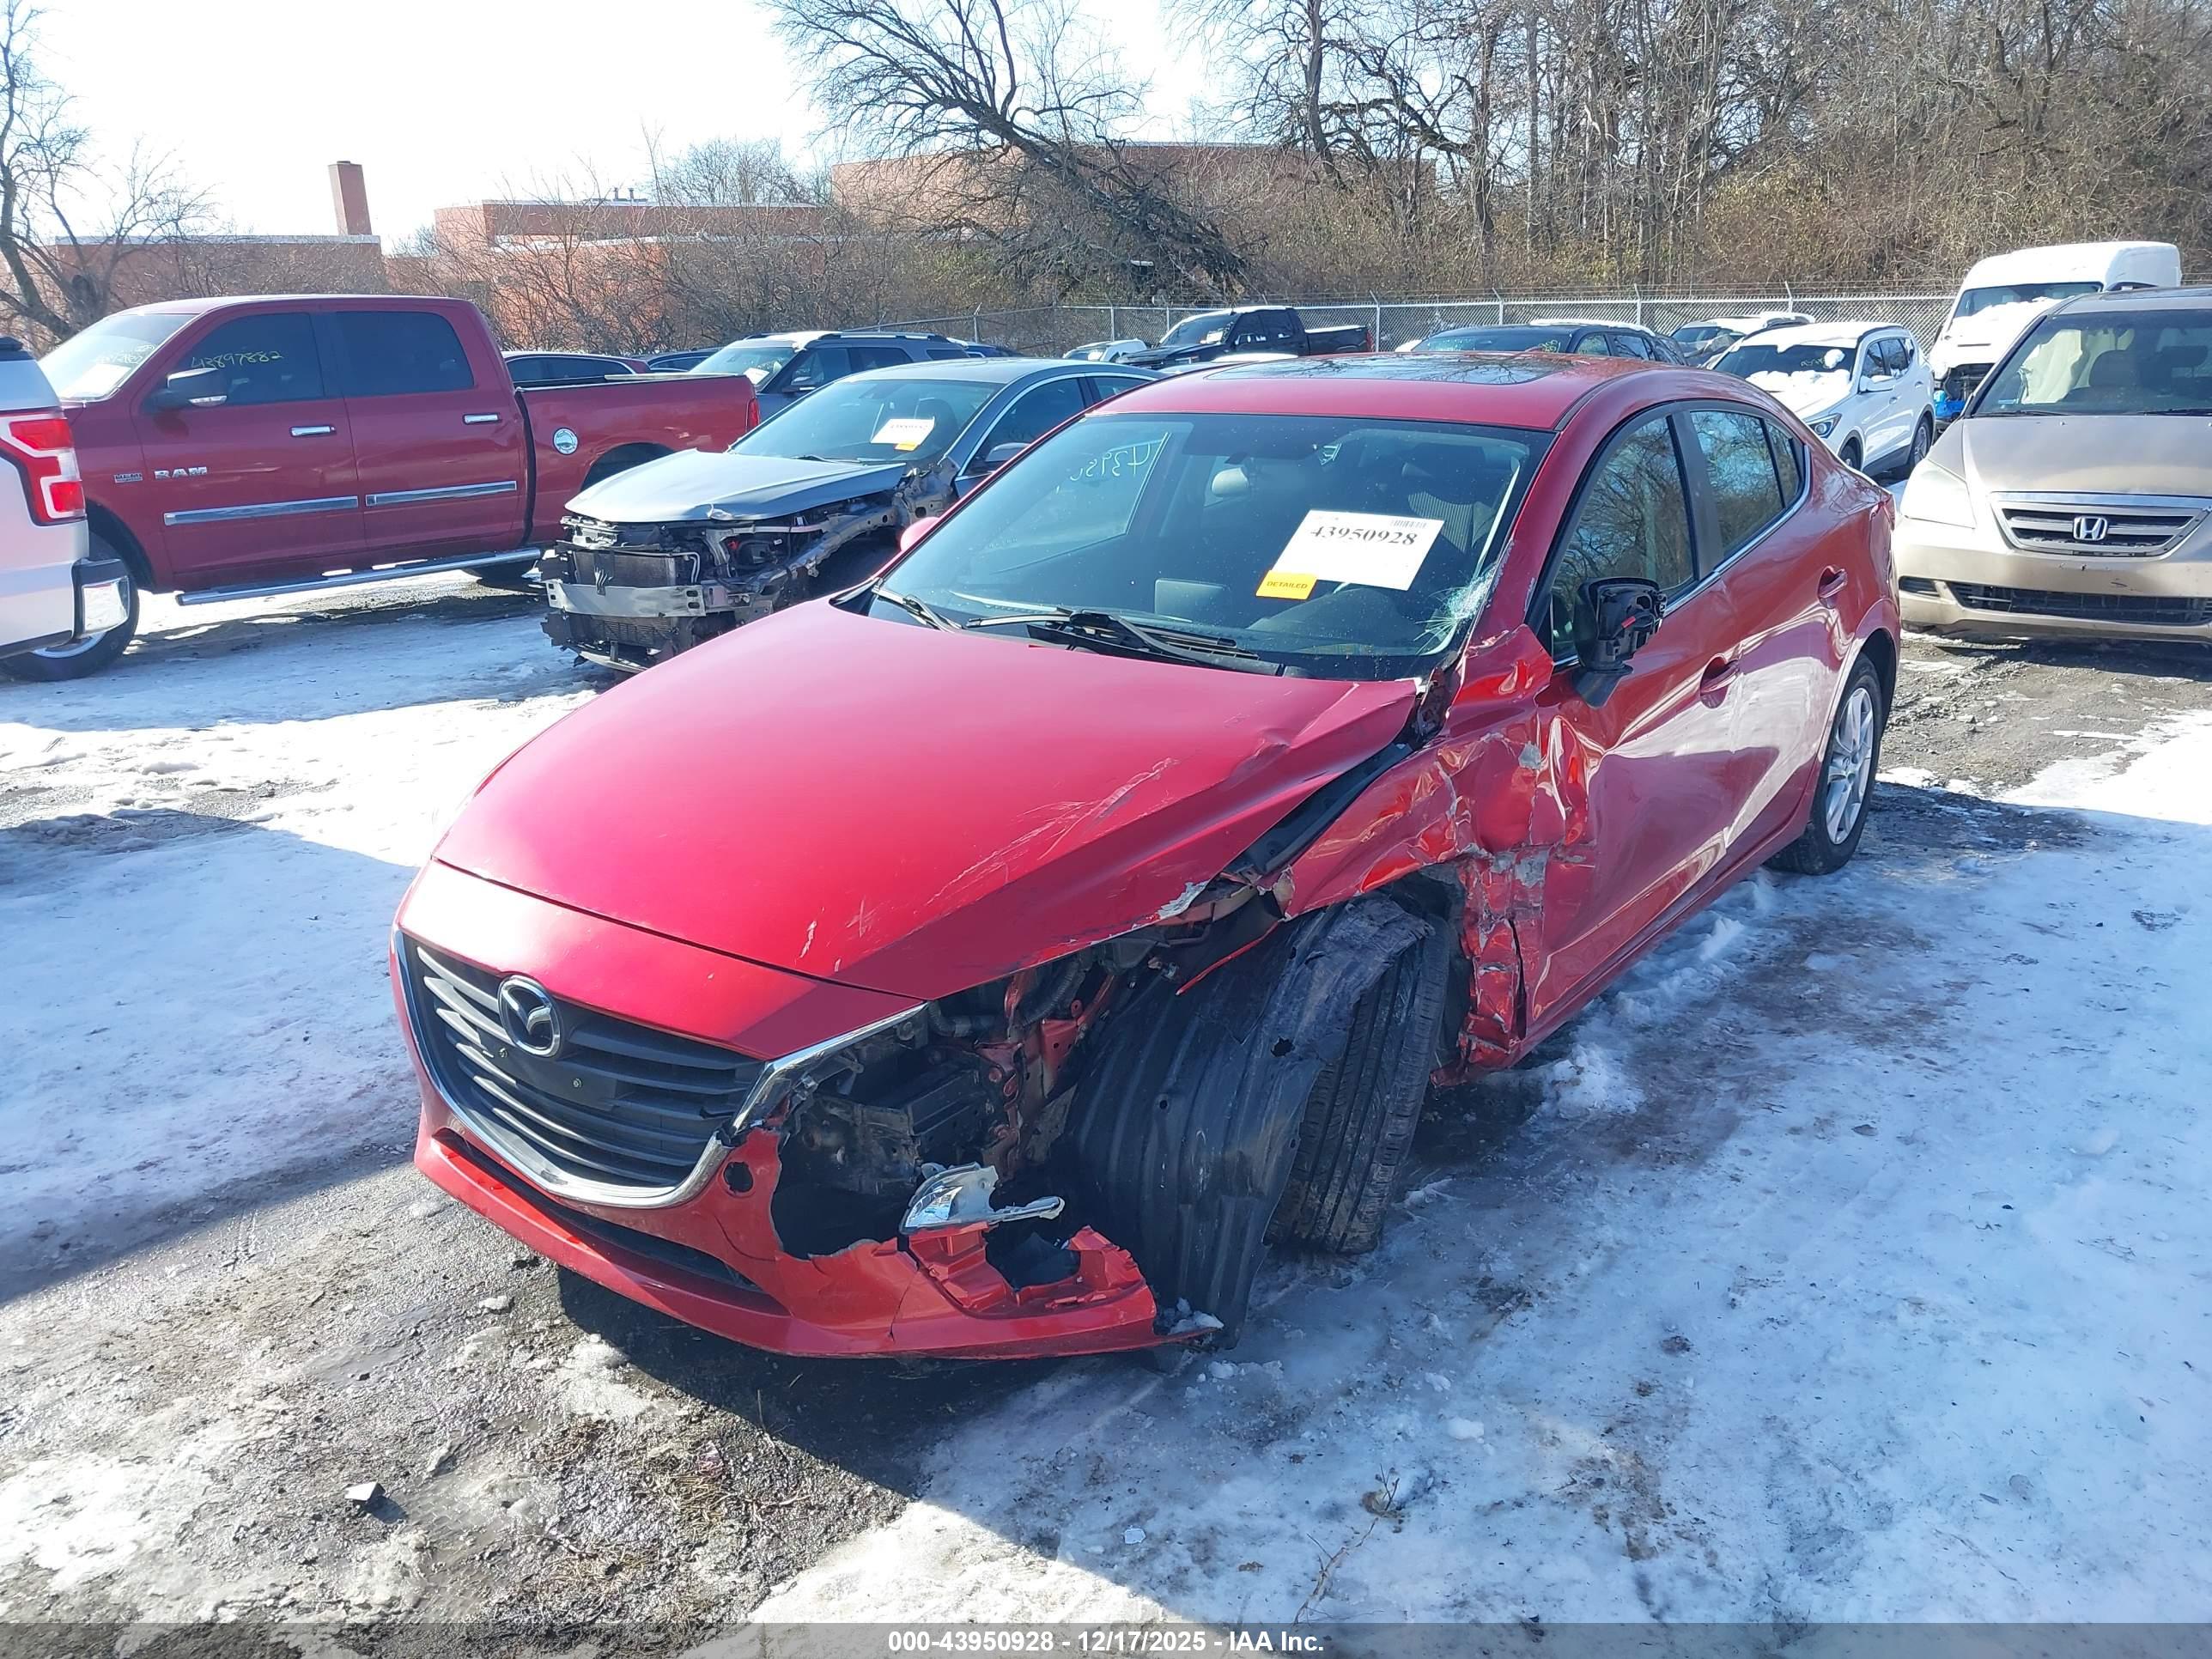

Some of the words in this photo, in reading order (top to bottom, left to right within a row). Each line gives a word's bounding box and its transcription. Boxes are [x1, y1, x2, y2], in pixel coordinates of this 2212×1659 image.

[155, 466, 207, 479] RAM
[1311, 526, 1418, 546] 43950928
[1267, 580, 1309, 589] DETAILED
